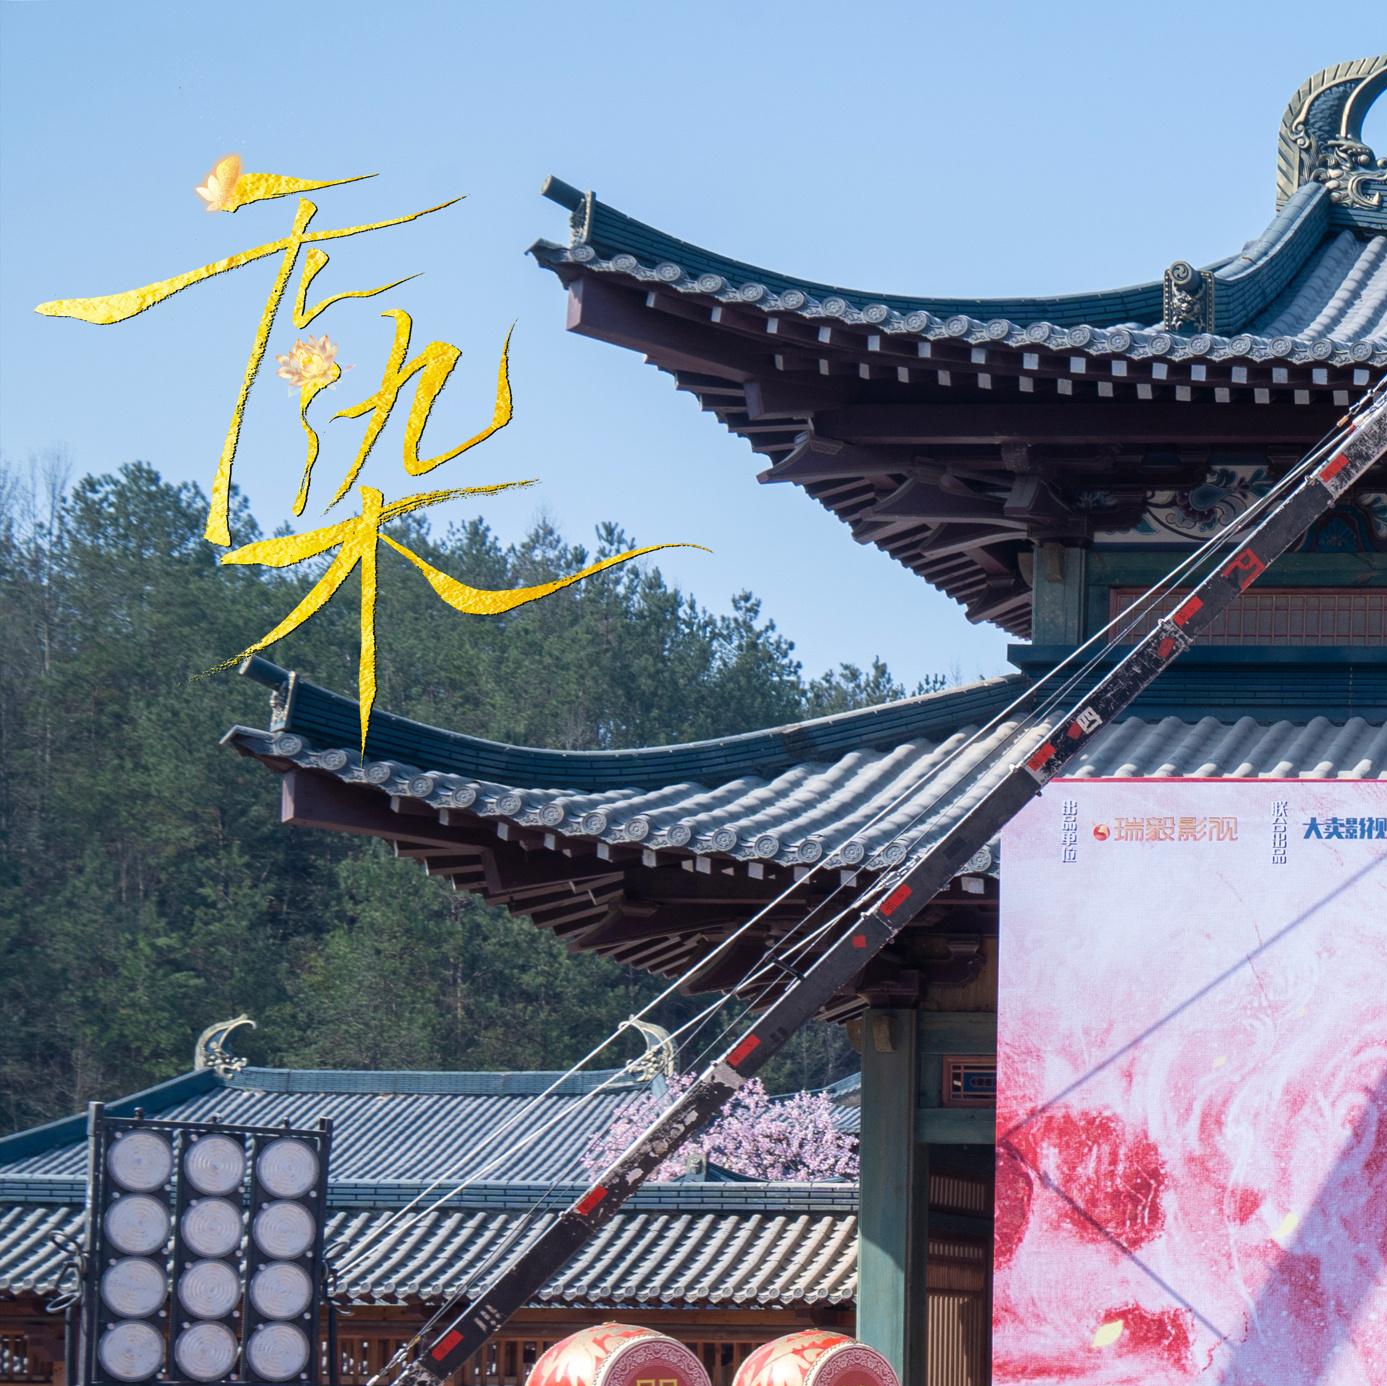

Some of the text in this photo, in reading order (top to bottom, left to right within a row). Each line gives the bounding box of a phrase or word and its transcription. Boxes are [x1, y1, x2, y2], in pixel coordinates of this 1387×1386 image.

[1061, 800, 1078, 864] 出品单位
[1114, 816, 1239, 842] 瑞毅影视
[1272, 800, 1288, 864] 联合出品
[1302, 816, 1387, 840] 大卖影视
